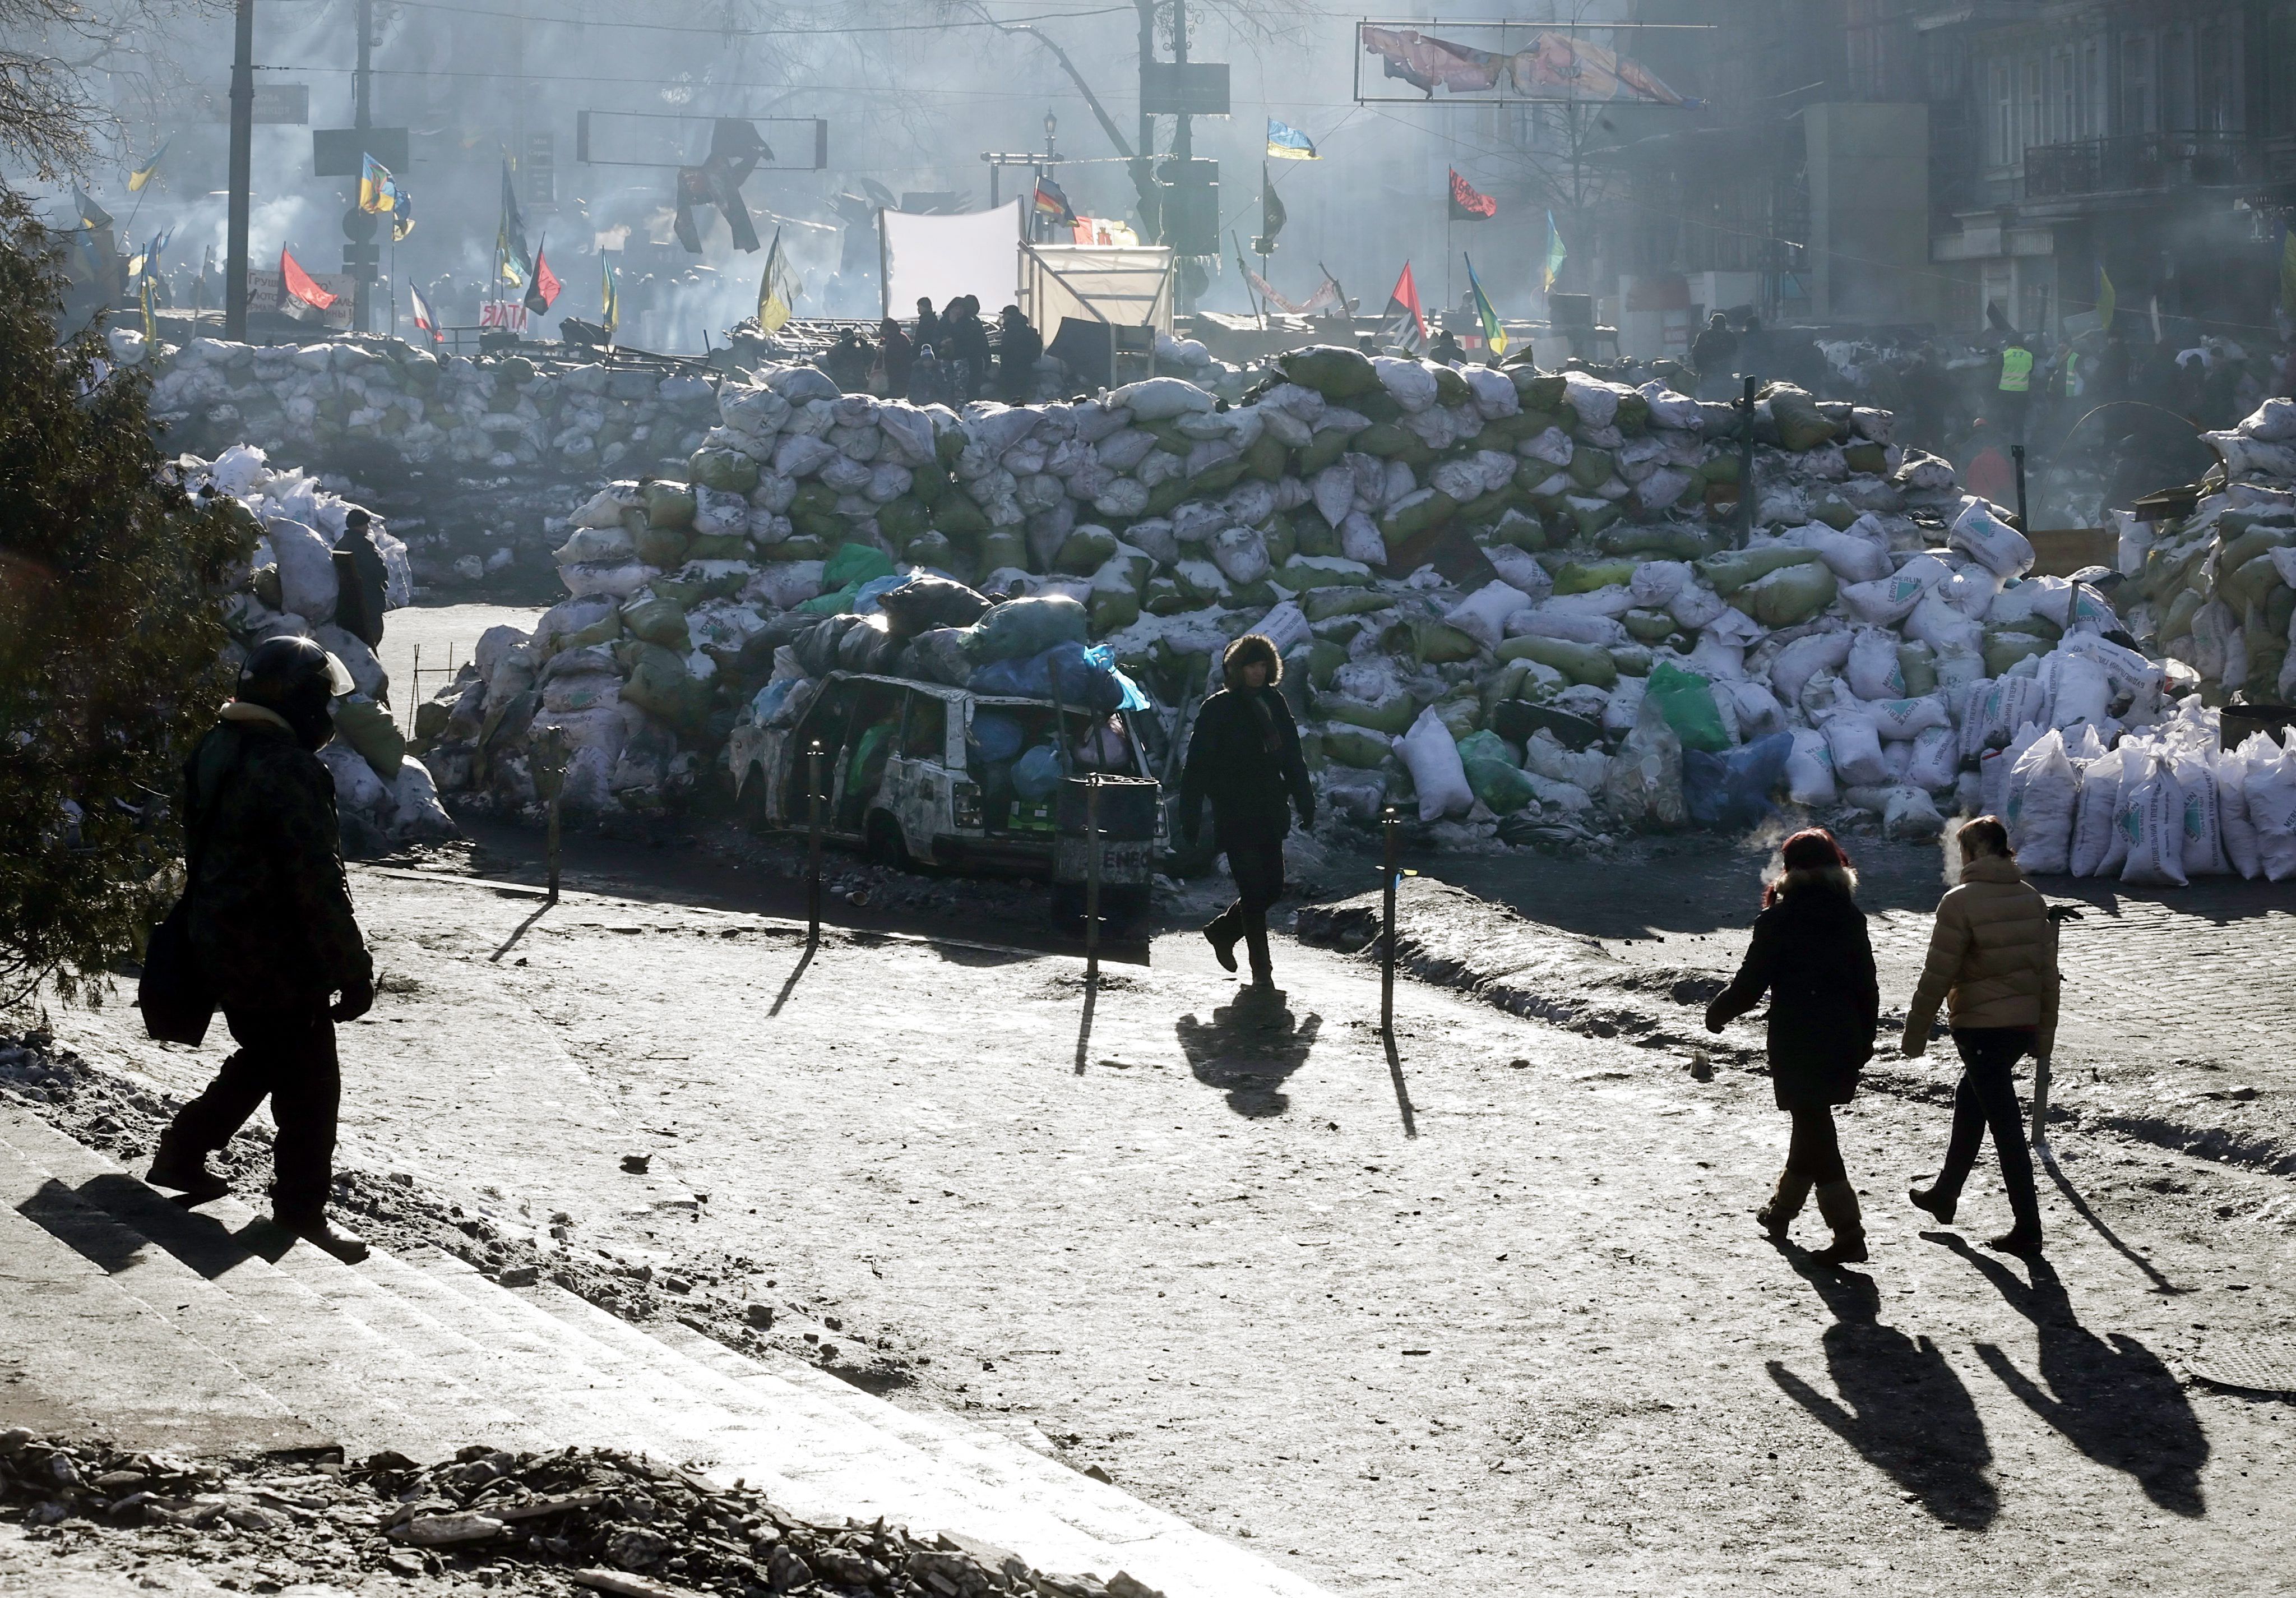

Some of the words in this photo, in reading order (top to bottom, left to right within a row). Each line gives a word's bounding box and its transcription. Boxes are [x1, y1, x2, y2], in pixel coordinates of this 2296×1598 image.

[481, 305, 527, 330] ЯЛТА
[1892, 575, 1922, 584] MERLIN
[1887, 581, 1898, 603] LEROY
[2110, 661, 2145, 689] БУДІВЕЛЬНИЙ
[2008, 678, 2017, 701] ГІПЕРМА
[1880, 703, 1906, 726] MERLIN
[1902, 699, 1922, 721] LEROY
[2184, 792, 2197, 808] LIN
[2284, 805, 2296, 828] MER
[2150, 823, 2161, 870] БУДІВЕЛЬНИЙ
[2210, 817, 2219, 867] БУДІВЕЛЬНИЙ
